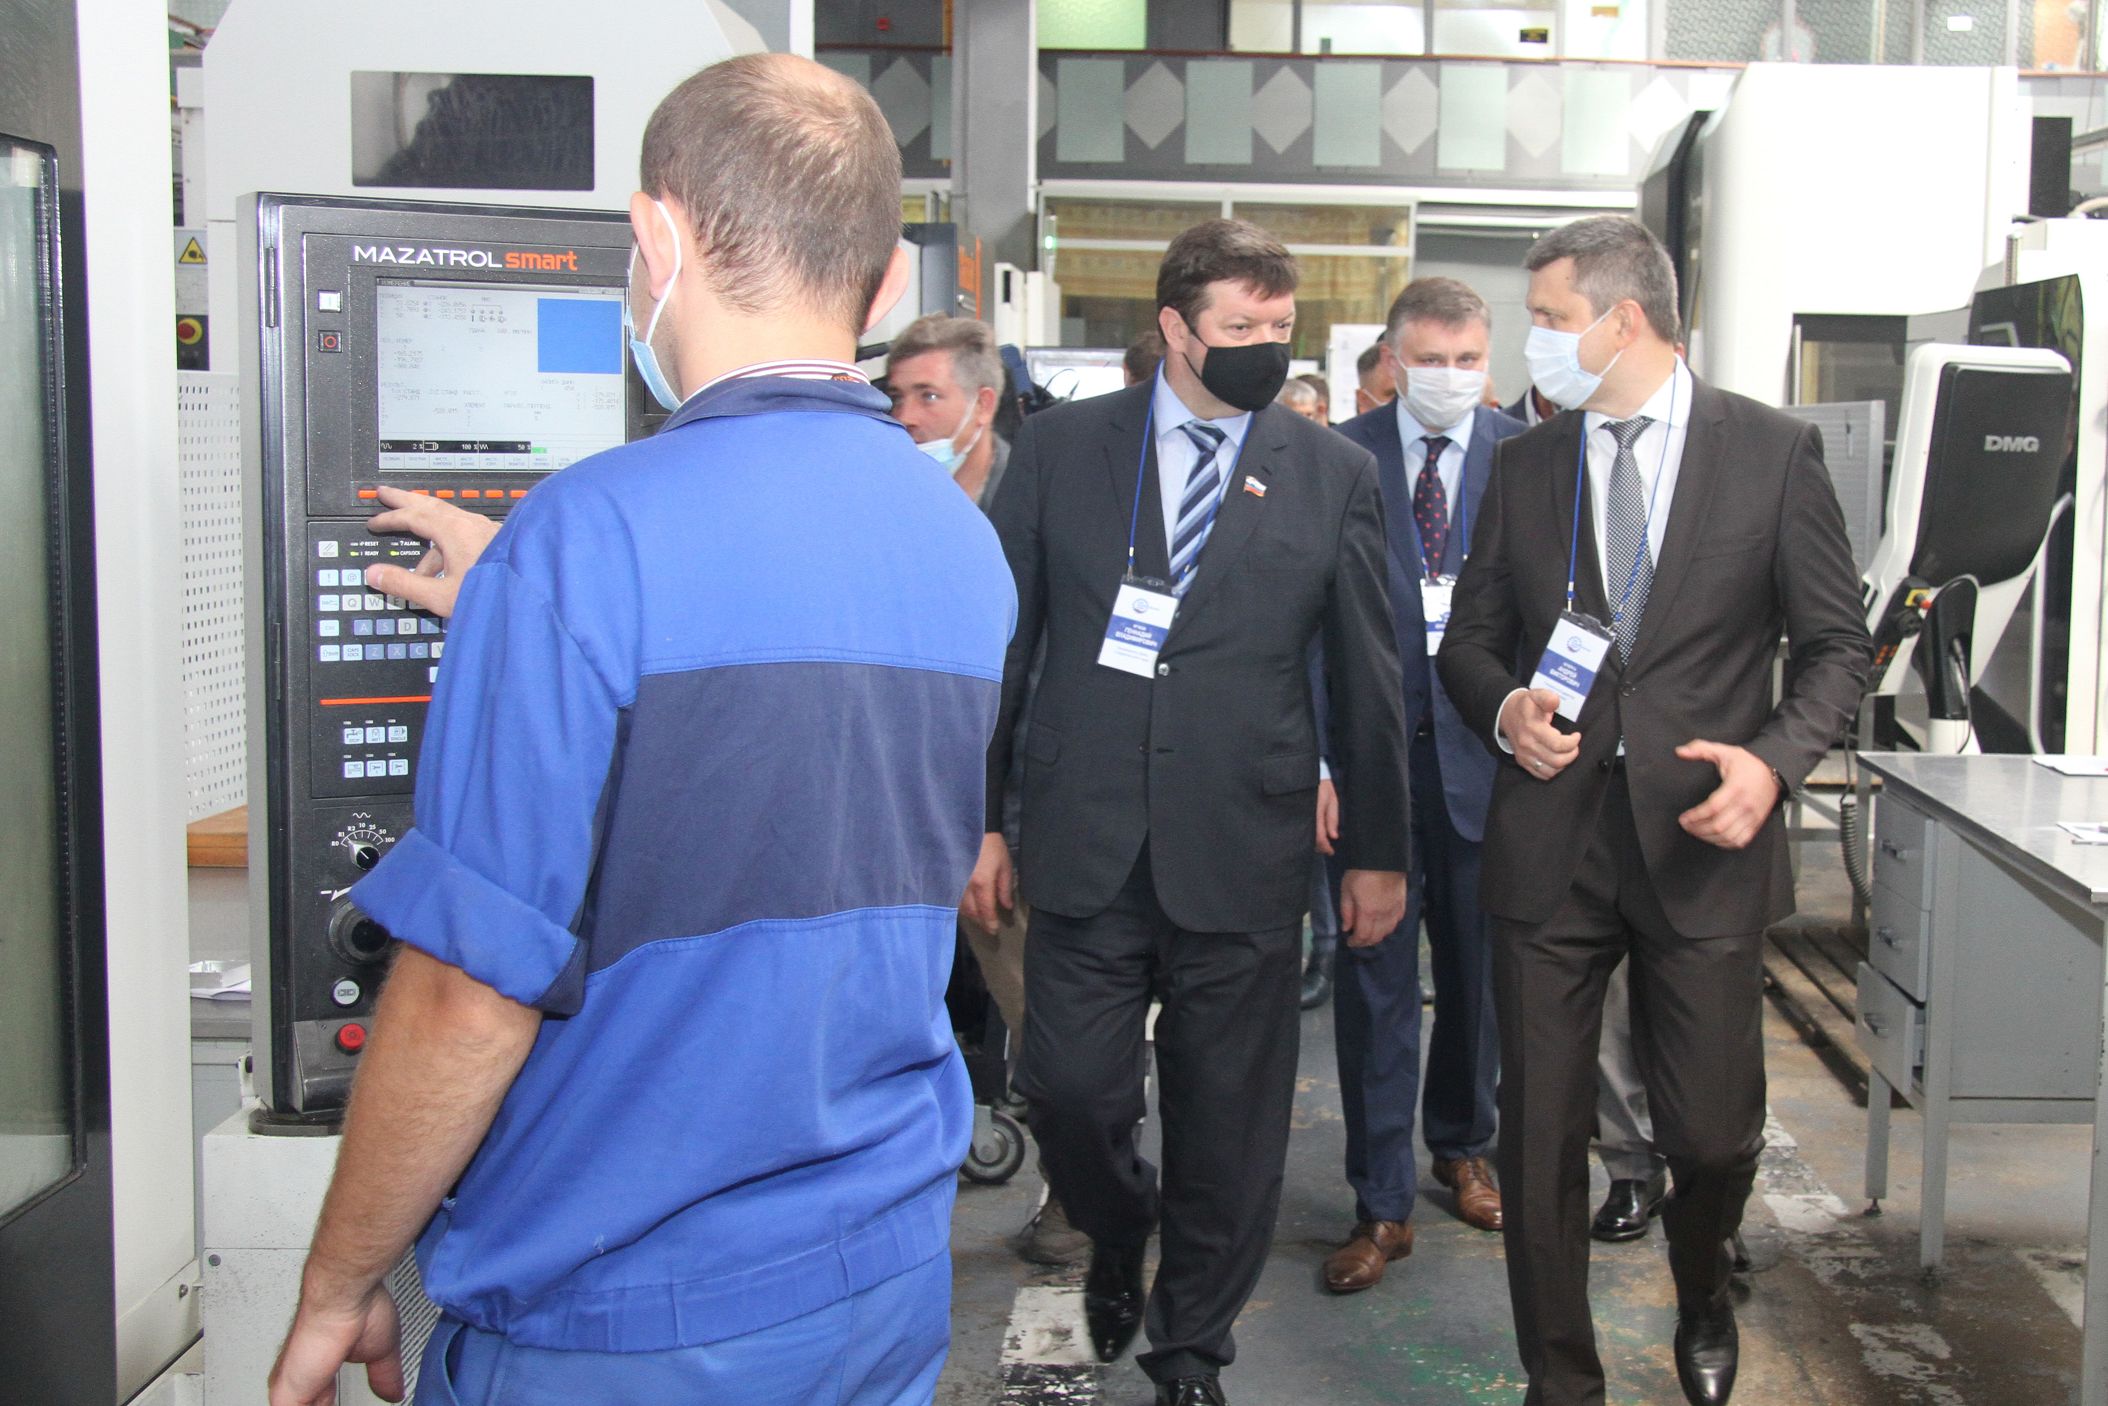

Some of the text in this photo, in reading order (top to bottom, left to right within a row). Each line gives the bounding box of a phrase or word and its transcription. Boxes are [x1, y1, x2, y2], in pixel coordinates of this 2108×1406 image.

[353, 245, 578, 271] MAZATROL smart
[517, 443, 526, 451] 50
[1984, 435, 2040, 452] DMG
[347, 598, 358, 608] Q
[368, 598, 380, 607] W
[360, 623, 369, 632] A
[382, 622, 388, 632] S
[404, 622, 411, 632] D
[371, 648, 378, 657] Z
[393, 647, 401, 656] X
[415, 645, 423, 655] C
